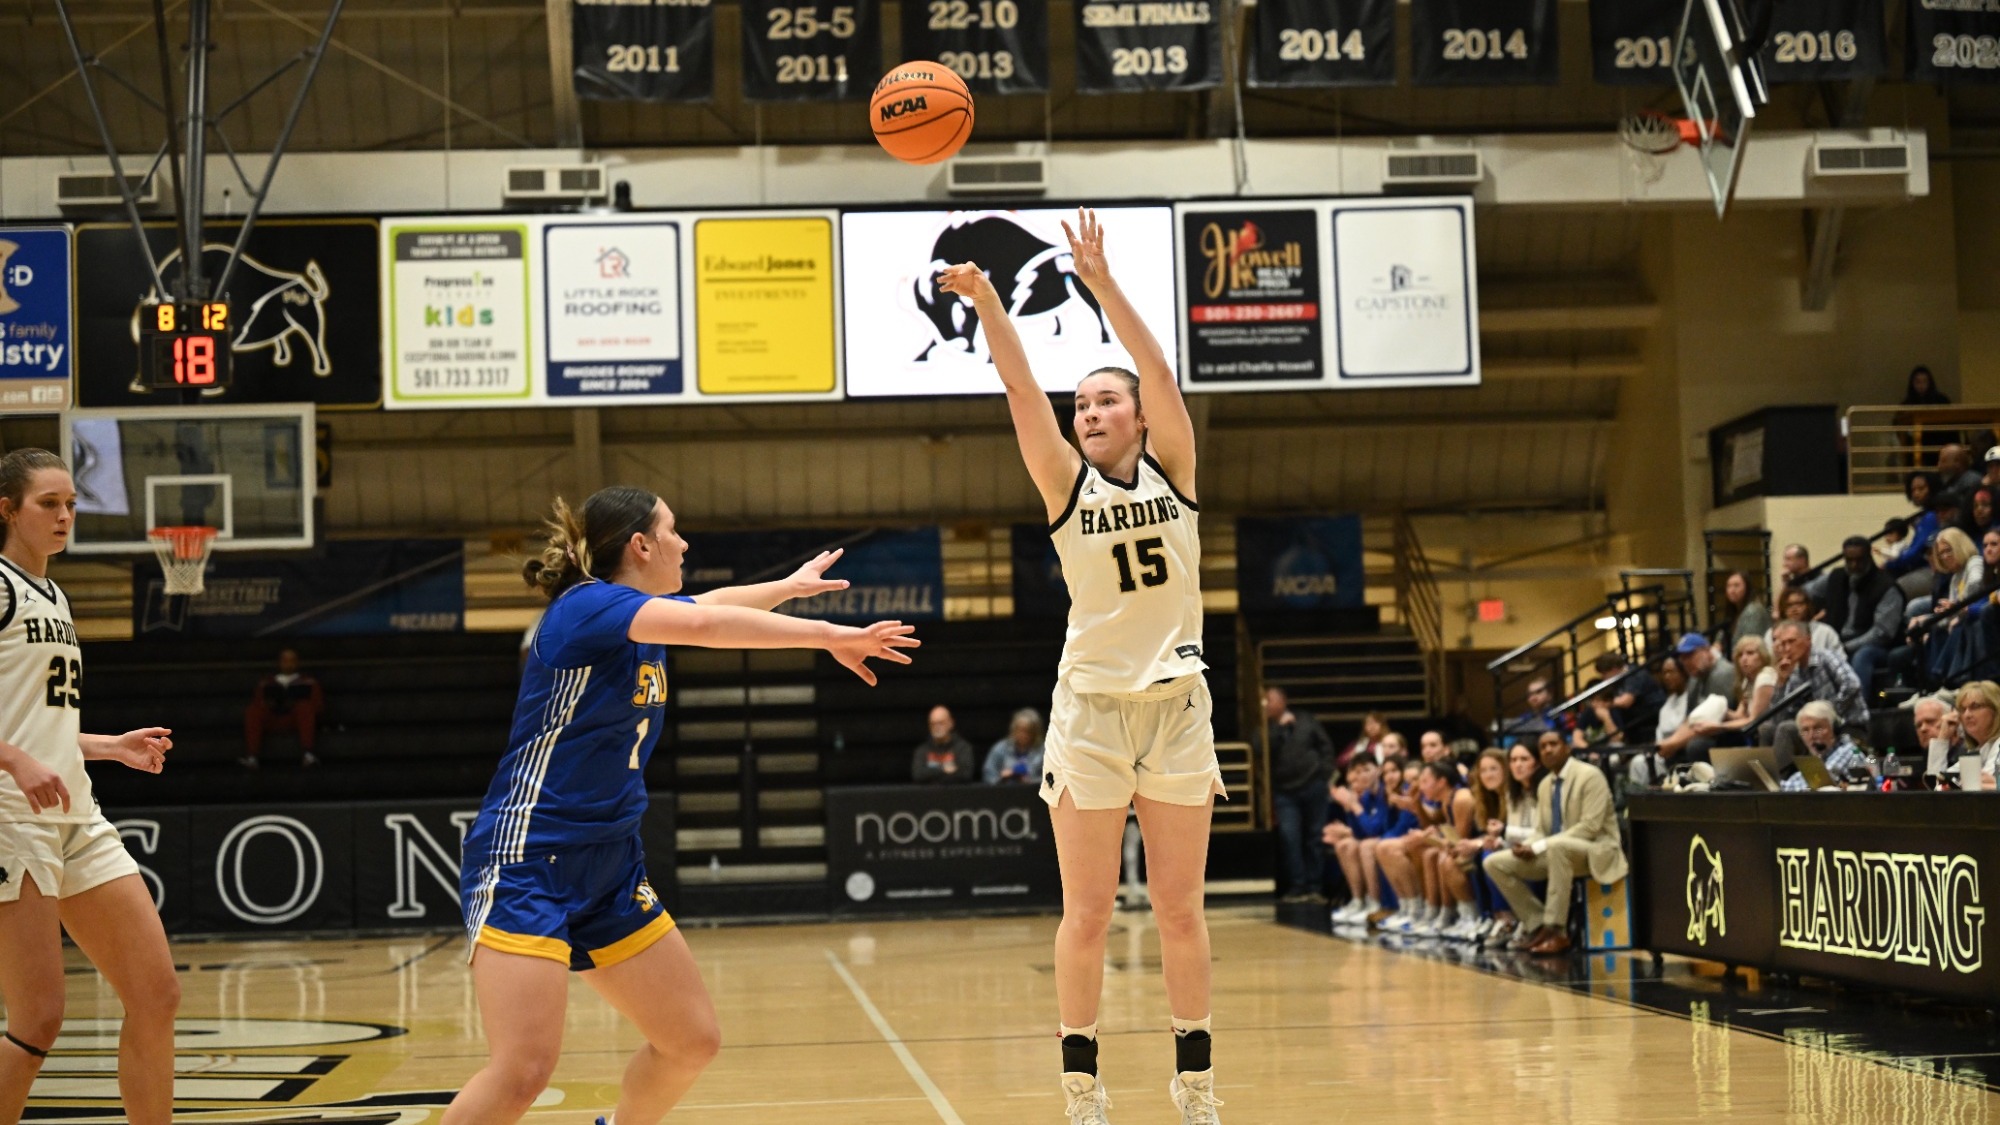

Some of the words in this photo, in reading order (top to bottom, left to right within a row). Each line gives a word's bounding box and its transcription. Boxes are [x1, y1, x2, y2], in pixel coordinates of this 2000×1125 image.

[767, 8, 856, 40] 25-5
[927, 1, 1018, 30] 22-10
[1083, 5, 1137, 27] SEMI
[1138, 1, 1211, 25] FINALS
[606, 44, 681, 73] 2011
[1279, 29, 1366, 61] 2014
[1442, 29, 1528, 60] 2014
[1774, 29, 1858, 63] 2016
[1931, 33, 2000, 69] 202
[776, 56, 850, 83] 2011
[1112, 45, 1189, 76] 2013
[880, 95, 928, 122] NCAA
[704, 256, 764, 272] Edward
[765, 256, 816, 273] Jones
[564, 290, 614, 298] LITTLE
[619, 288, 659, 297] ROCK
[1355, 296, 1450, 312] CAPSTONE
[158, 304, 175, 332] 8
[202, 303, 228, 331] 12
[425, 304, 494, 327] kids
[565, 302, 661, 316] ROOFING
[9, 321, 58, 341] family
[173, 336, 216, 384] 18
[415, 369, 509, 387] 501.733.3317
[1080, 495, 1180, 535] HARDING
[1111, 536, 1169, 593] 15
[1273, 575, 1337, 596] NCAA
[46, 655, 81, 710] 23
[628, 718, 650, 770] 1
[1776, 847, 1986, 974] HARDING
